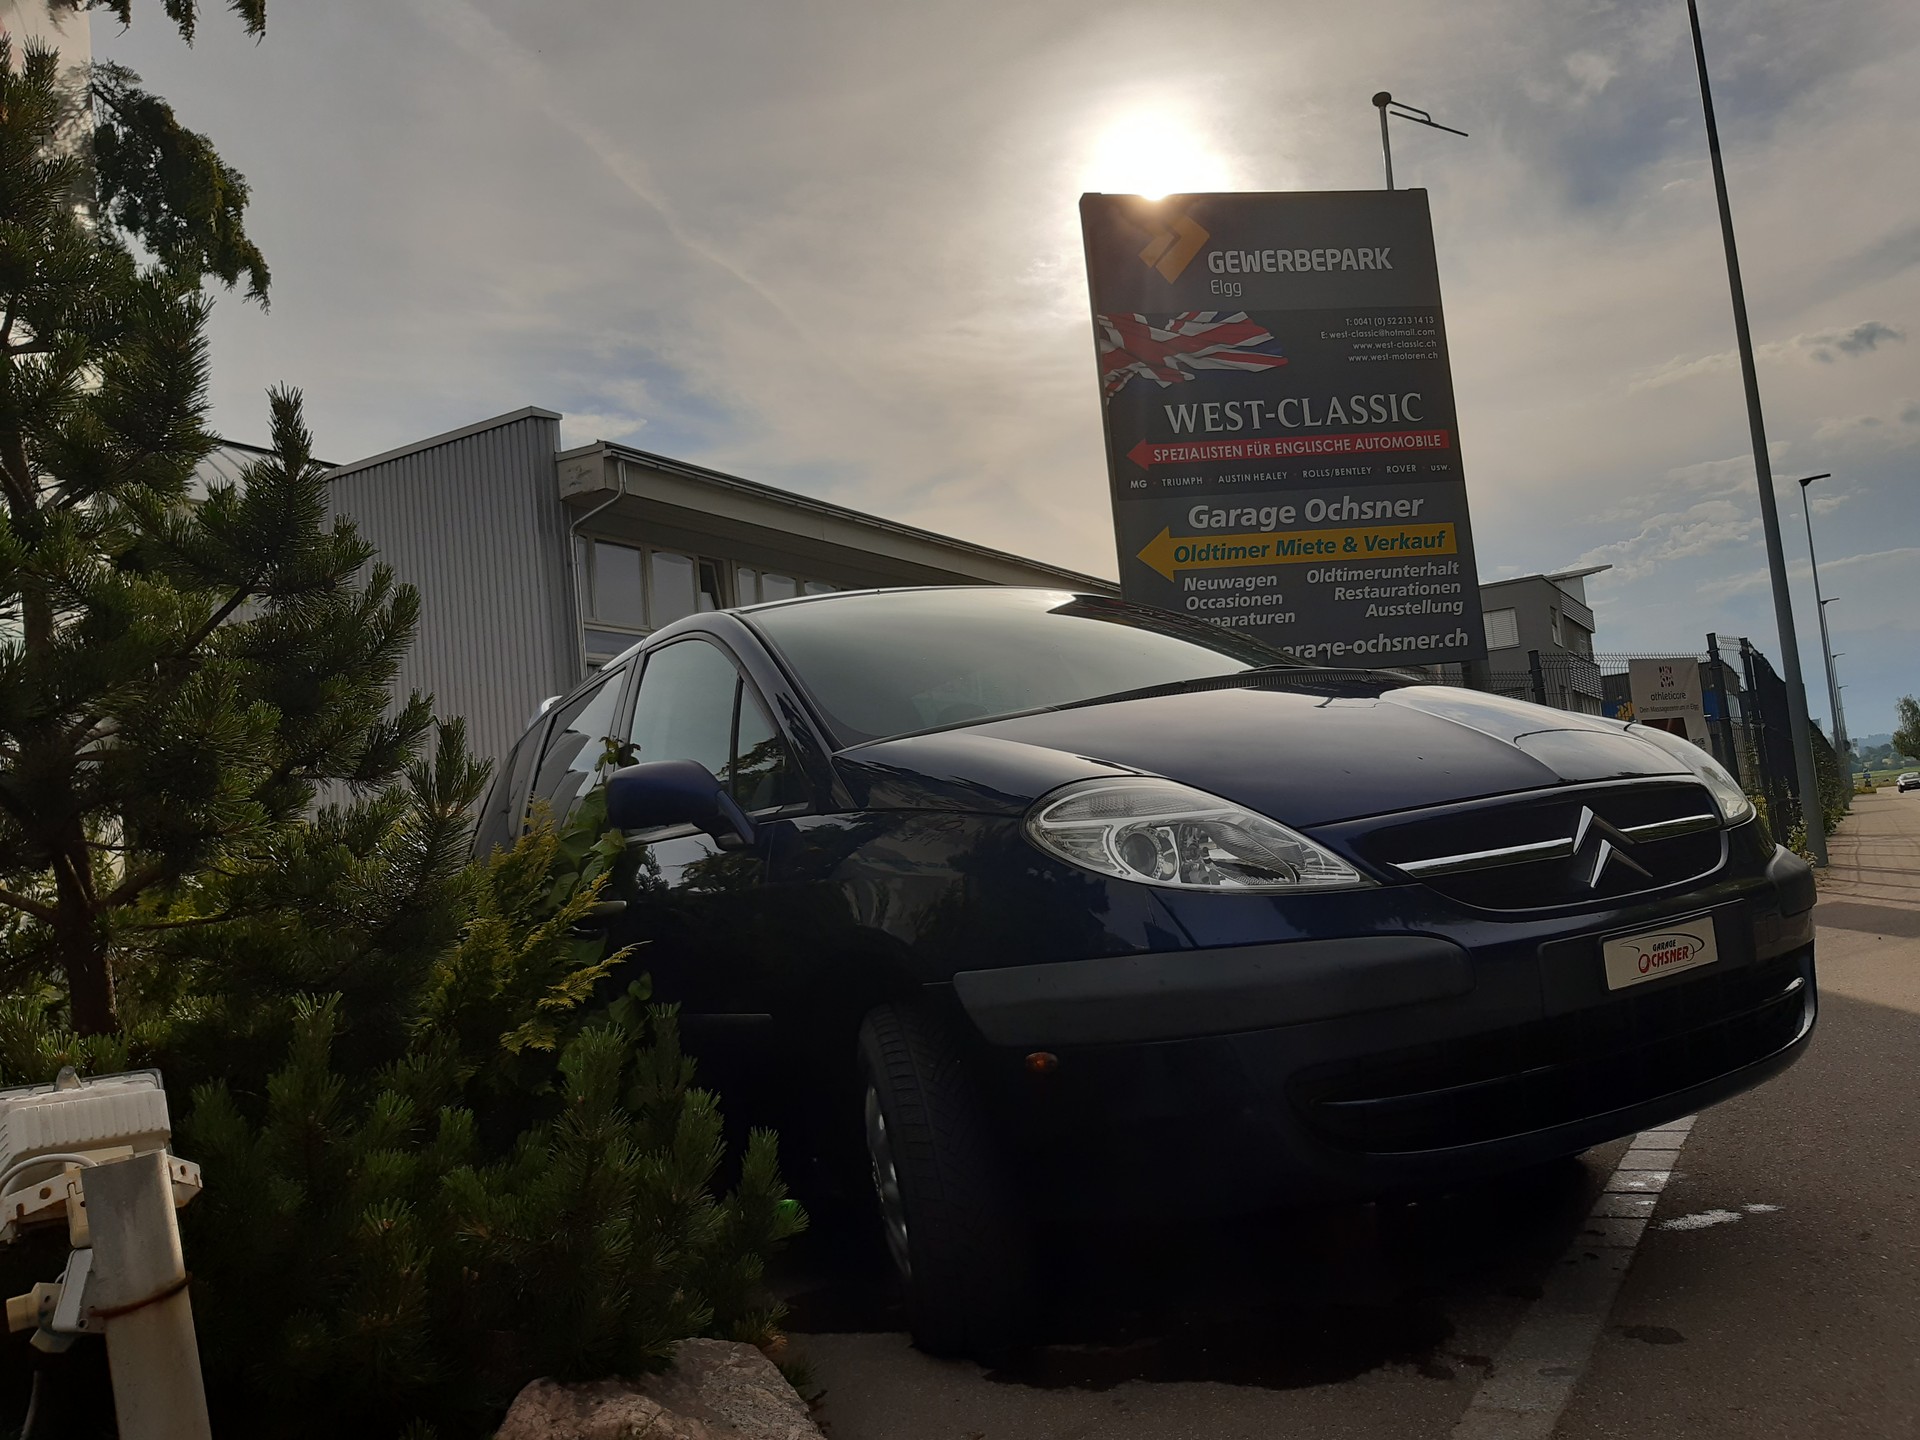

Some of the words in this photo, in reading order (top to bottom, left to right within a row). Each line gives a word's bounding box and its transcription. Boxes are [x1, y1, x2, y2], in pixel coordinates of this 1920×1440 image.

[1207, 247, 1393, 274] GEWERBEPARK
[1210, 279, 1242, 298] Elgg
[1353, 318, 1372, 326] 0041
[1374, 318, 1386, 327] (0)
[1329, 328, 1436, 339] west-classic@hotmail.com
[1352, 340, 1437, 350] www.west-classic.ch
[1348, 351, 1438, 362] www.west-motoren.ch
[1164, 392, 1425, 435] WEST-CLASSIC
[1153, 445, 1243, 462] SPEZIALISTEN
[1247, 441, 1271, 457] FÜR
[1275, 438, 1351, 455] ENGLISCHE
[1355, 435, 1441, 450] AUTOMOBILE
[1130, 480, 1148, 489] MG
[1162, 477, 1203, 487] TRIUMPH
[1218, 474, 1251, 484] AUSTIN
[1253, 471, 1288, 481] HEALEY
[1302, 466, 1372, 478] ROLLS/BENTLEY
[1386, 464, 1417, 474] ROVER
[1188, 505, 1296, 532] Garage
[1304, 496, 1424, 523] Ochsner
[1173, 543, 1271, 563] Oldtimer
[1275, 538, 1337, 557] Miete
[1342, 536, 1358, 552] &
[1364, 530, 1446, 552] Verkauf
[1306, 561, 1460, 584] Oldtimerunterhalt
[1183, 575, 1278, 592] Neuwagen
[1334, 582, 1461, 601] Restaurationen
[1186, 593, 1283, 611] Occasionen
[1364, 600, 1464, 618] Ausstellung
[1652, 939, 1677, 952] GARAGE
[1638, 945, 1689, 974] OCHSNER
